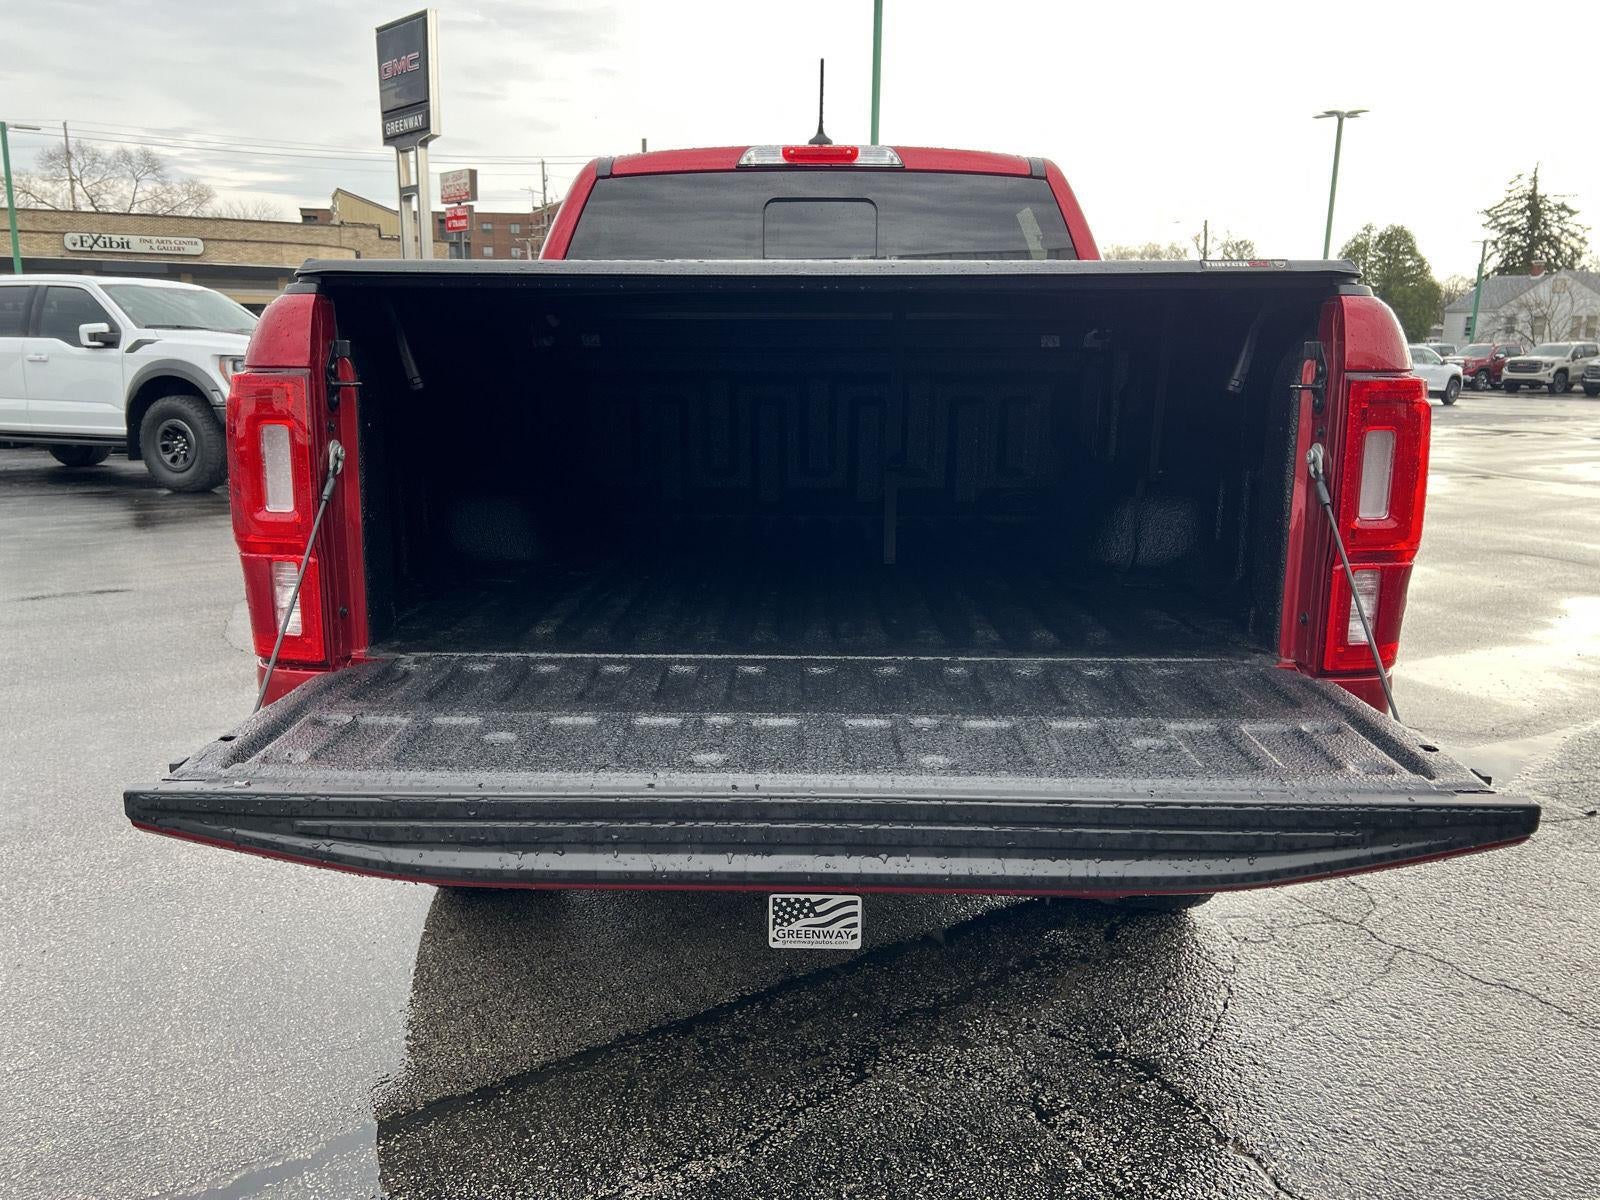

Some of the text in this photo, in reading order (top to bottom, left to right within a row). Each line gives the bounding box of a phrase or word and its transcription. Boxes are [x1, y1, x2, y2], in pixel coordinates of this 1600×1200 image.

[381, 52, 420, 80] GMC
[385, 114, 423, 135] GREENWAY
[79, 233, 132, 250] EXibit
[155, 238, 172, 246] ARTS
[173, 239, 198, 247] CENTER
[776, 928, 852, 939] GREENWAY
